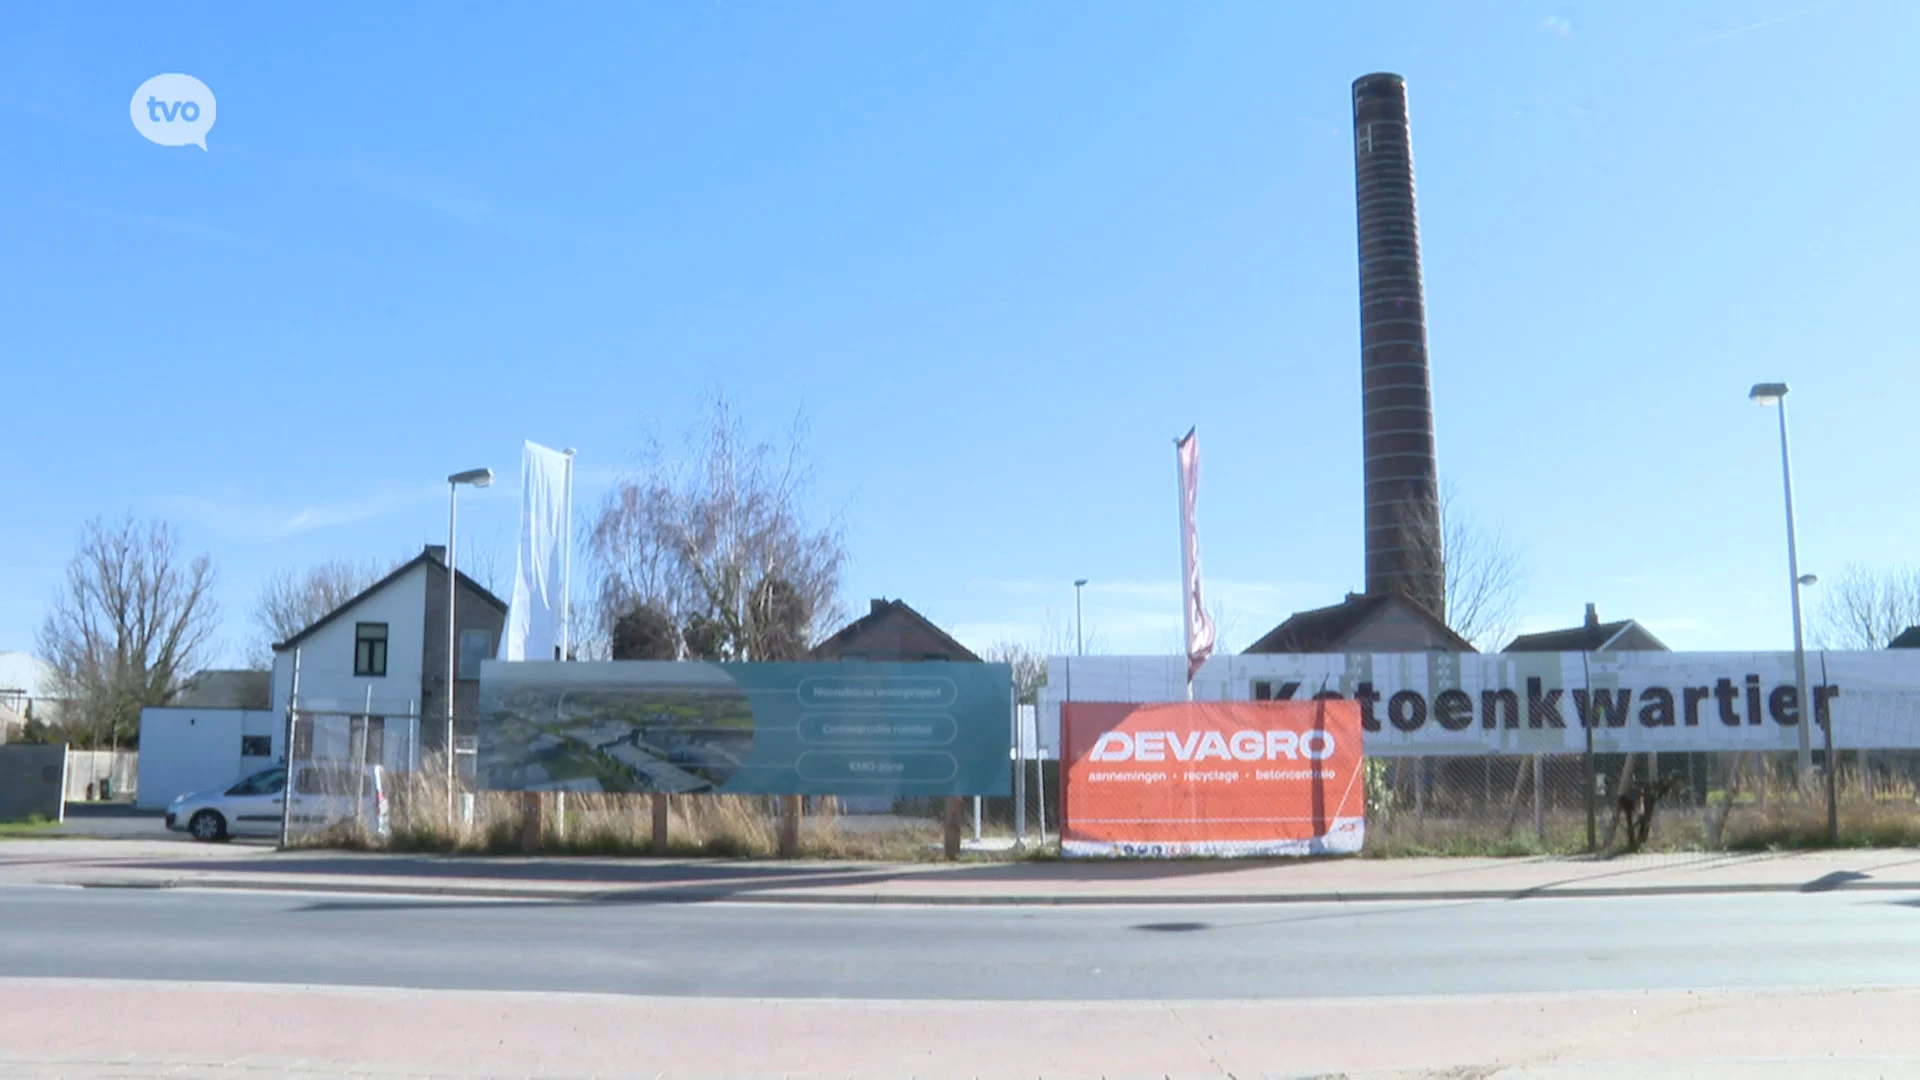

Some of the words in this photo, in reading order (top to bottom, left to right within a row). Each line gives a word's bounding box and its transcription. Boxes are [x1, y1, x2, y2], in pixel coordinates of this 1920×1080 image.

[1254, 674, 1839, 731] toenkwartier
[1088, 730, 1335, 762] DEVAGRO
[1088, 769, 1167, 783] aannemingen
[1183, 768, 1239, 783] recyclage
